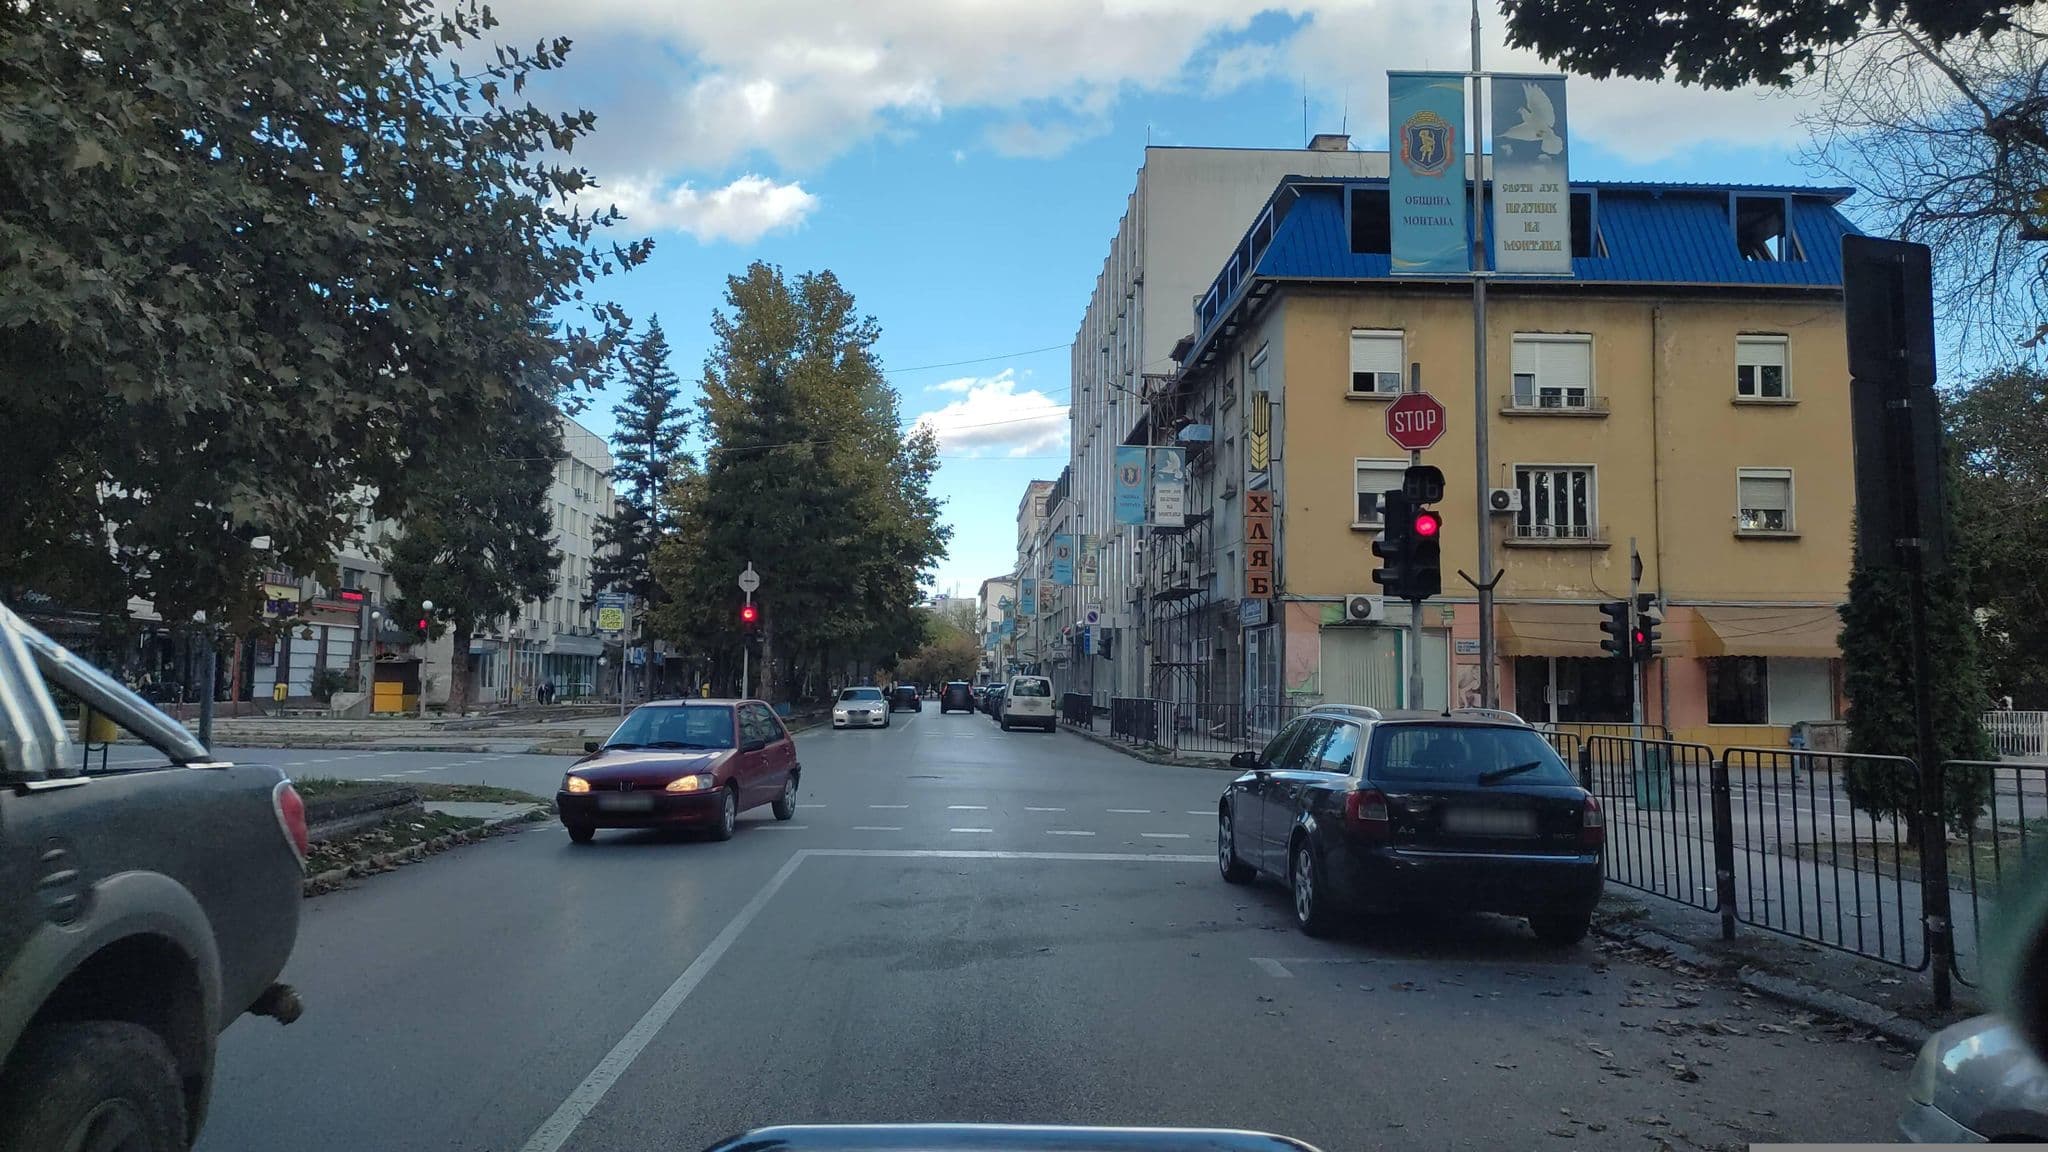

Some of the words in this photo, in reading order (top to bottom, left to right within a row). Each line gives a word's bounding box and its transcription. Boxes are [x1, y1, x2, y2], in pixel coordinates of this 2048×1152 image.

[1539, 183, 1559, 193] ДУХ
[1405, 195, 1451, 206] ОБЩИНА
[1402, 215, 1454, 227] МОНТАНА
[1524, 221, 1540, 233] НА
[1503, 240, 1562, 251] МОНТАНА
[1394, 409, 1436, 432] STOP
[1249, 496, 1268, 594] ХЛЯБ
